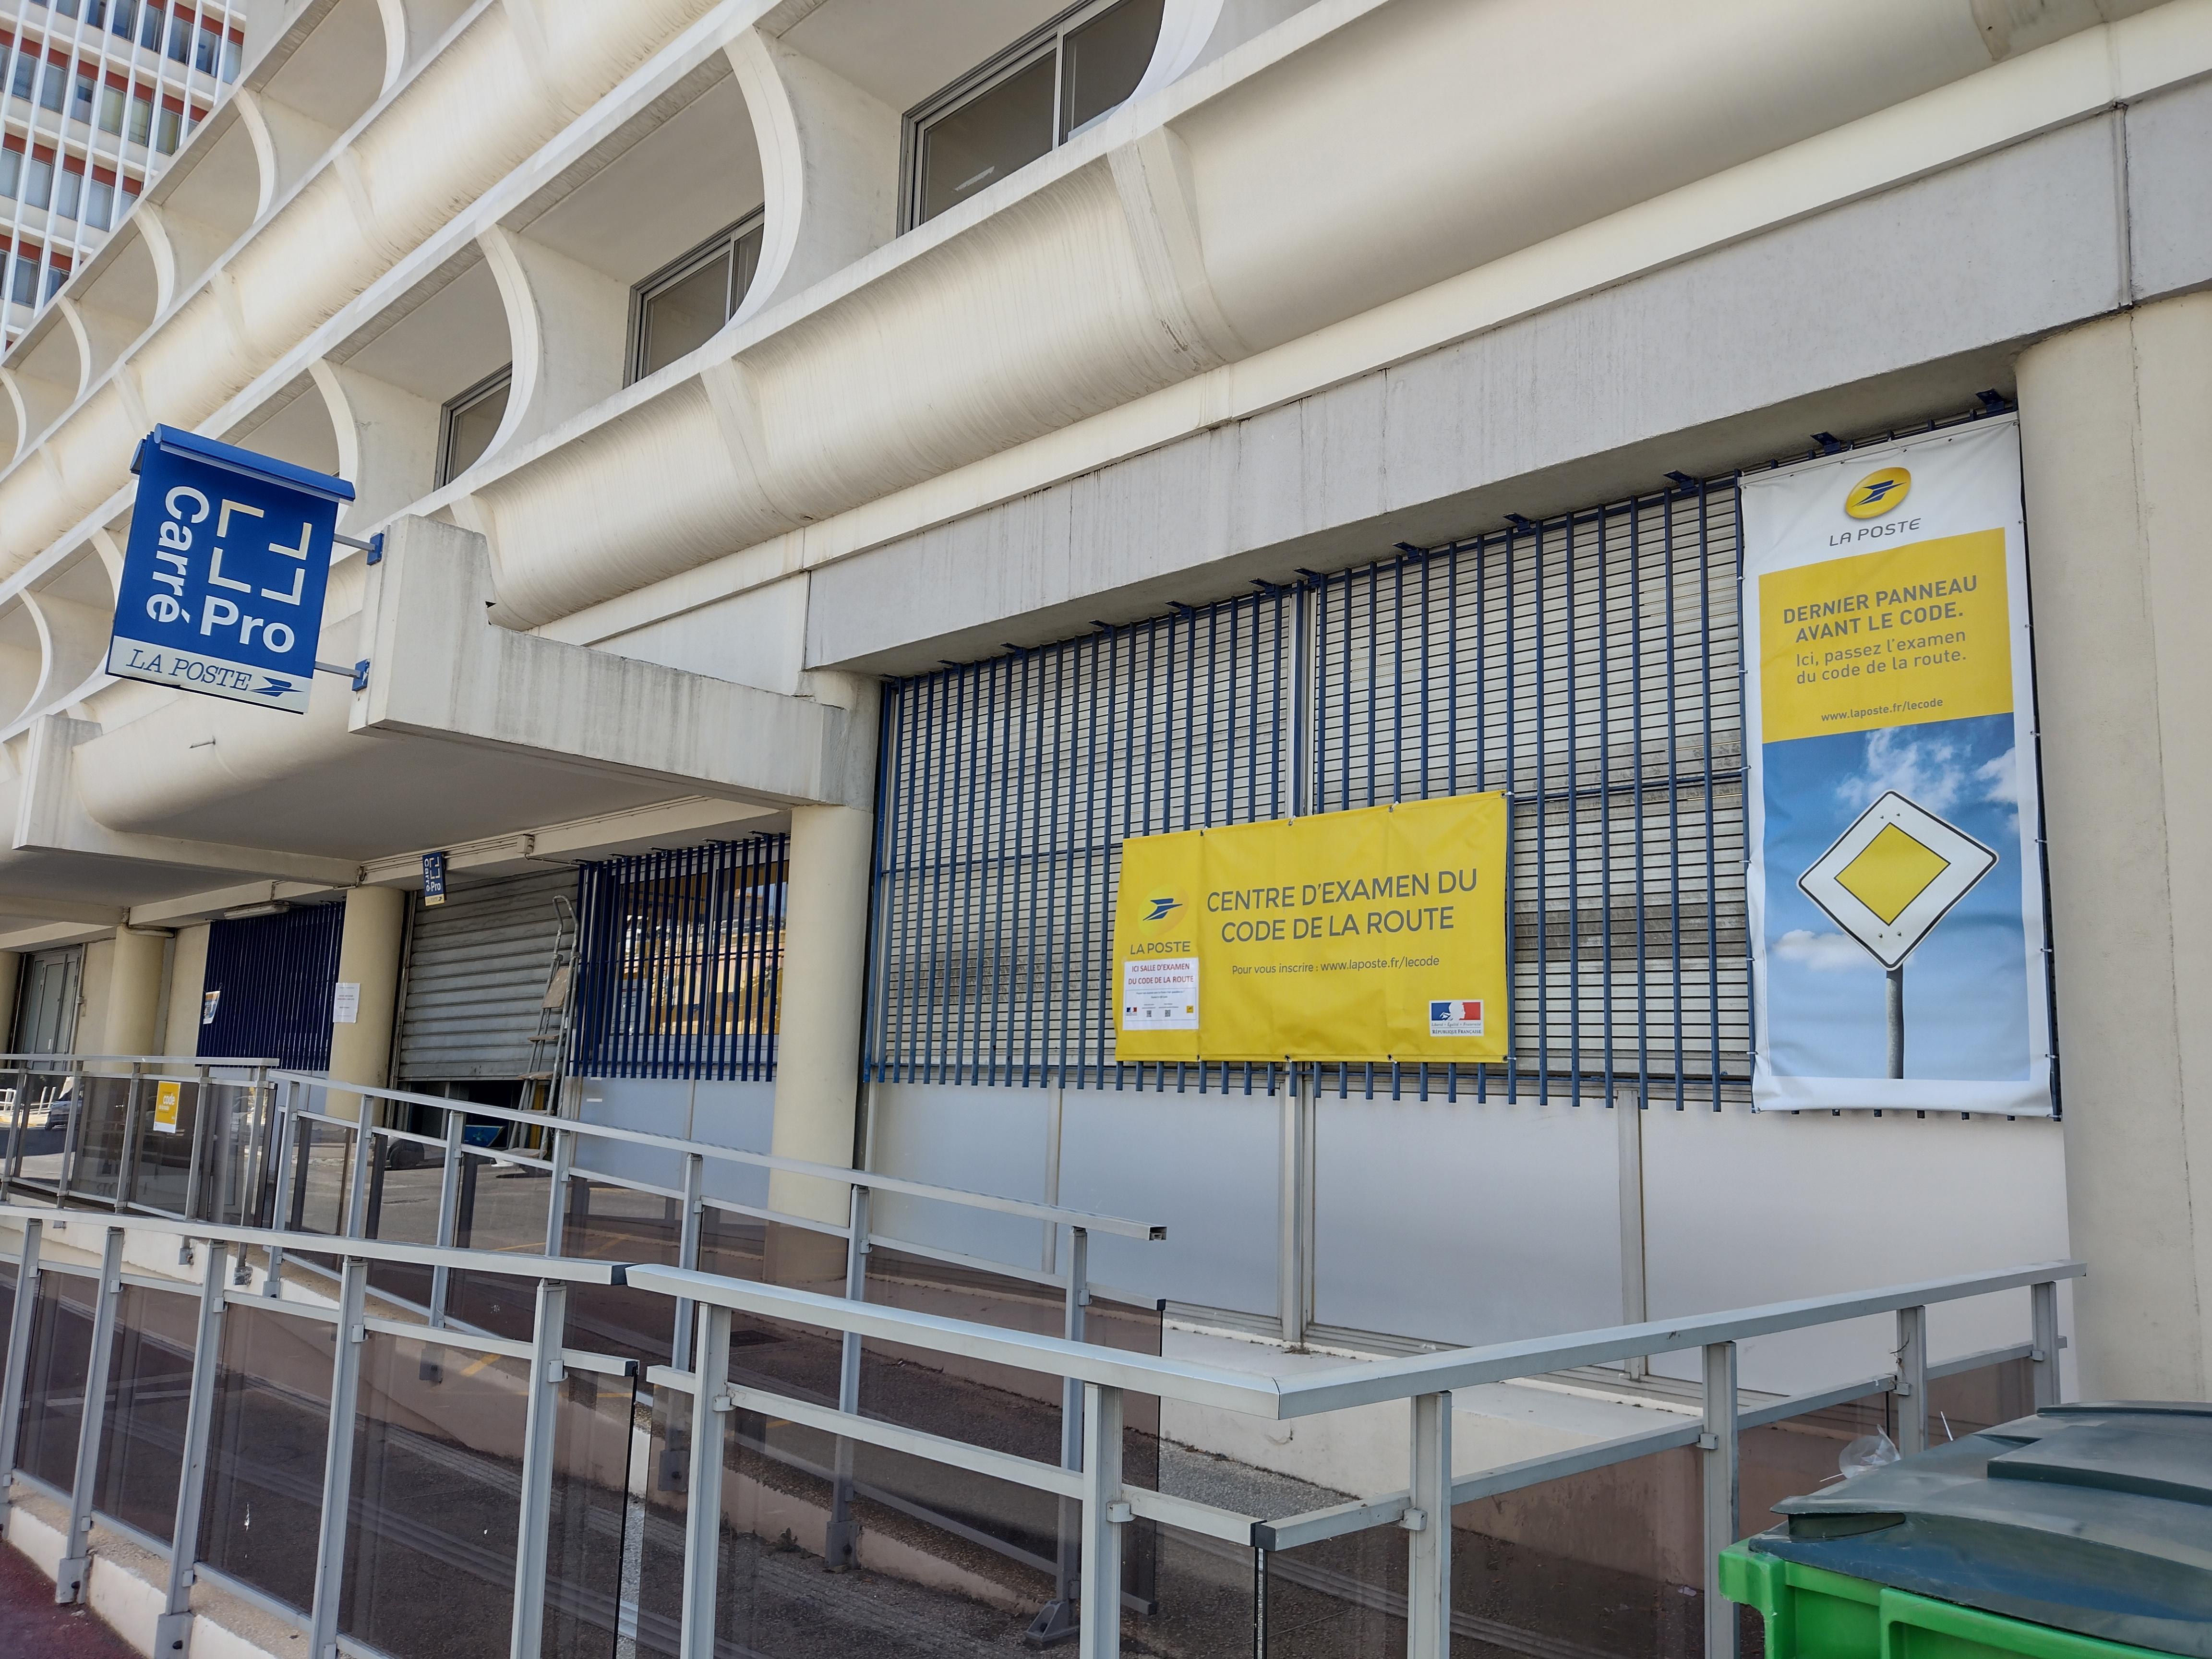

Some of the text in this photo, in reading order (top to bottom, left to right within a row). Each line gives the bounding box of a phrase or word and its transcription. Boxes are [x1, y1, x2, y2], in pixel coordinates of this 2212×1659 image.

[1829, 517, 1922, 547] LA POSTE
[146, 486, 209, 624] Carré
[1783, 575, 1977, 624] DERNIER PANNEAU
[200, 595, 294, 653] Pro
[1795, 601, 1963, 643] AVANT LE CODE.
[1796, 631, 1966, 667] Ici, passez l'examen
[1797, 649, 1966, 685] du code de la route.
[126, 649, 252, 691] LA POSTE
[1821, 697, 1944, 722] www.laposte.fr/lecode
[431, 881, 441, 891] Pro
[1207, 868, 1477, 912] CENTRE D'EXAMEN DU
[1222, 906, 1454, 943] CODE DE LA ROUTE
[1130, 941, 1190, 955] LA POSTE
[1232, 965, 1252, 974] Pour
[1254, 965, 1276, 974] vous
[1279, 962, 1313, 973] inscrire
[1321, 955, 1440, 972] www.laposte.fr/lecode
[163, 1093, 175, 1105] code
